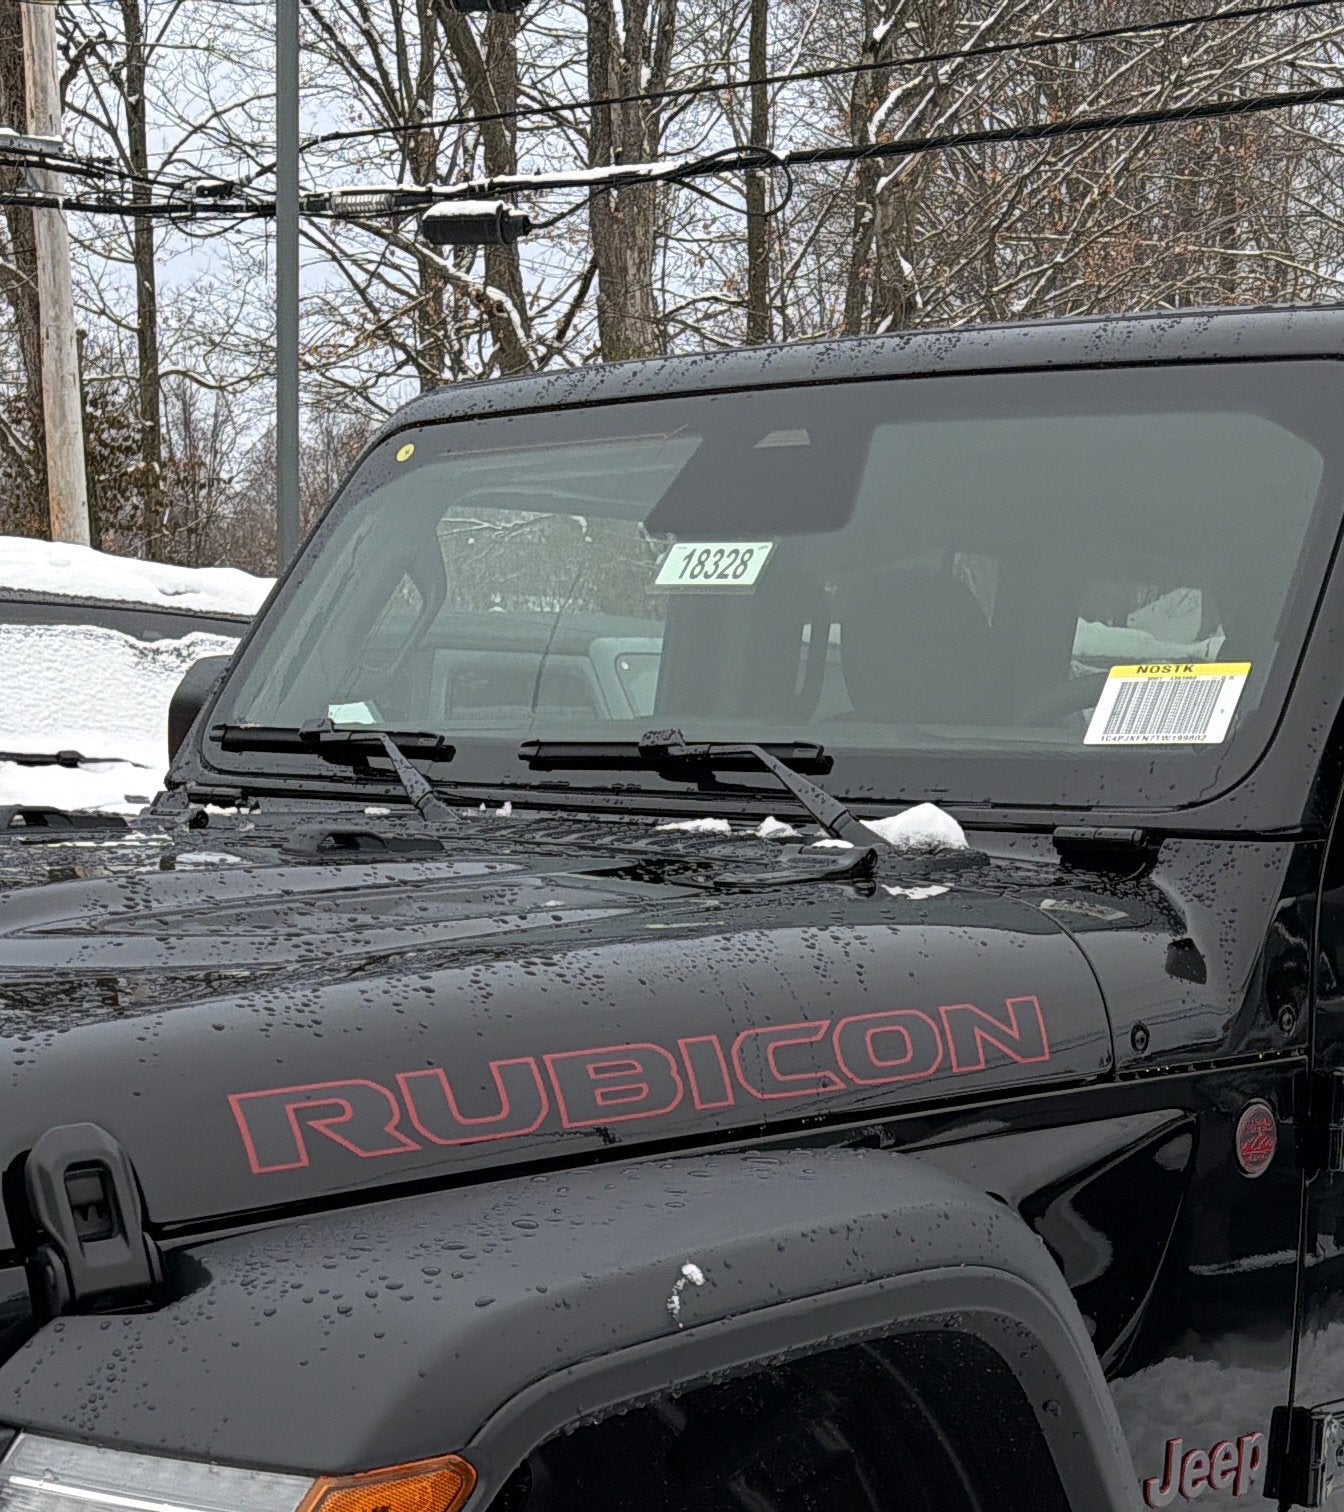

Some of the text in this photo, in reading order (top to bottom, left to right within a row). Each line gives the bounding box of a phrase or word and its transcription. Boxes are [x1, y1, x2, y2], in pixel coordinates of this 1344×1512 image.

[678, 548, 754, 580] 18328
[1136, 664, 1195, 674] NOSTK
[227, 995, 1052, 1174] RUBICON
[1143, 1431, 1264, 1509] Jeep
